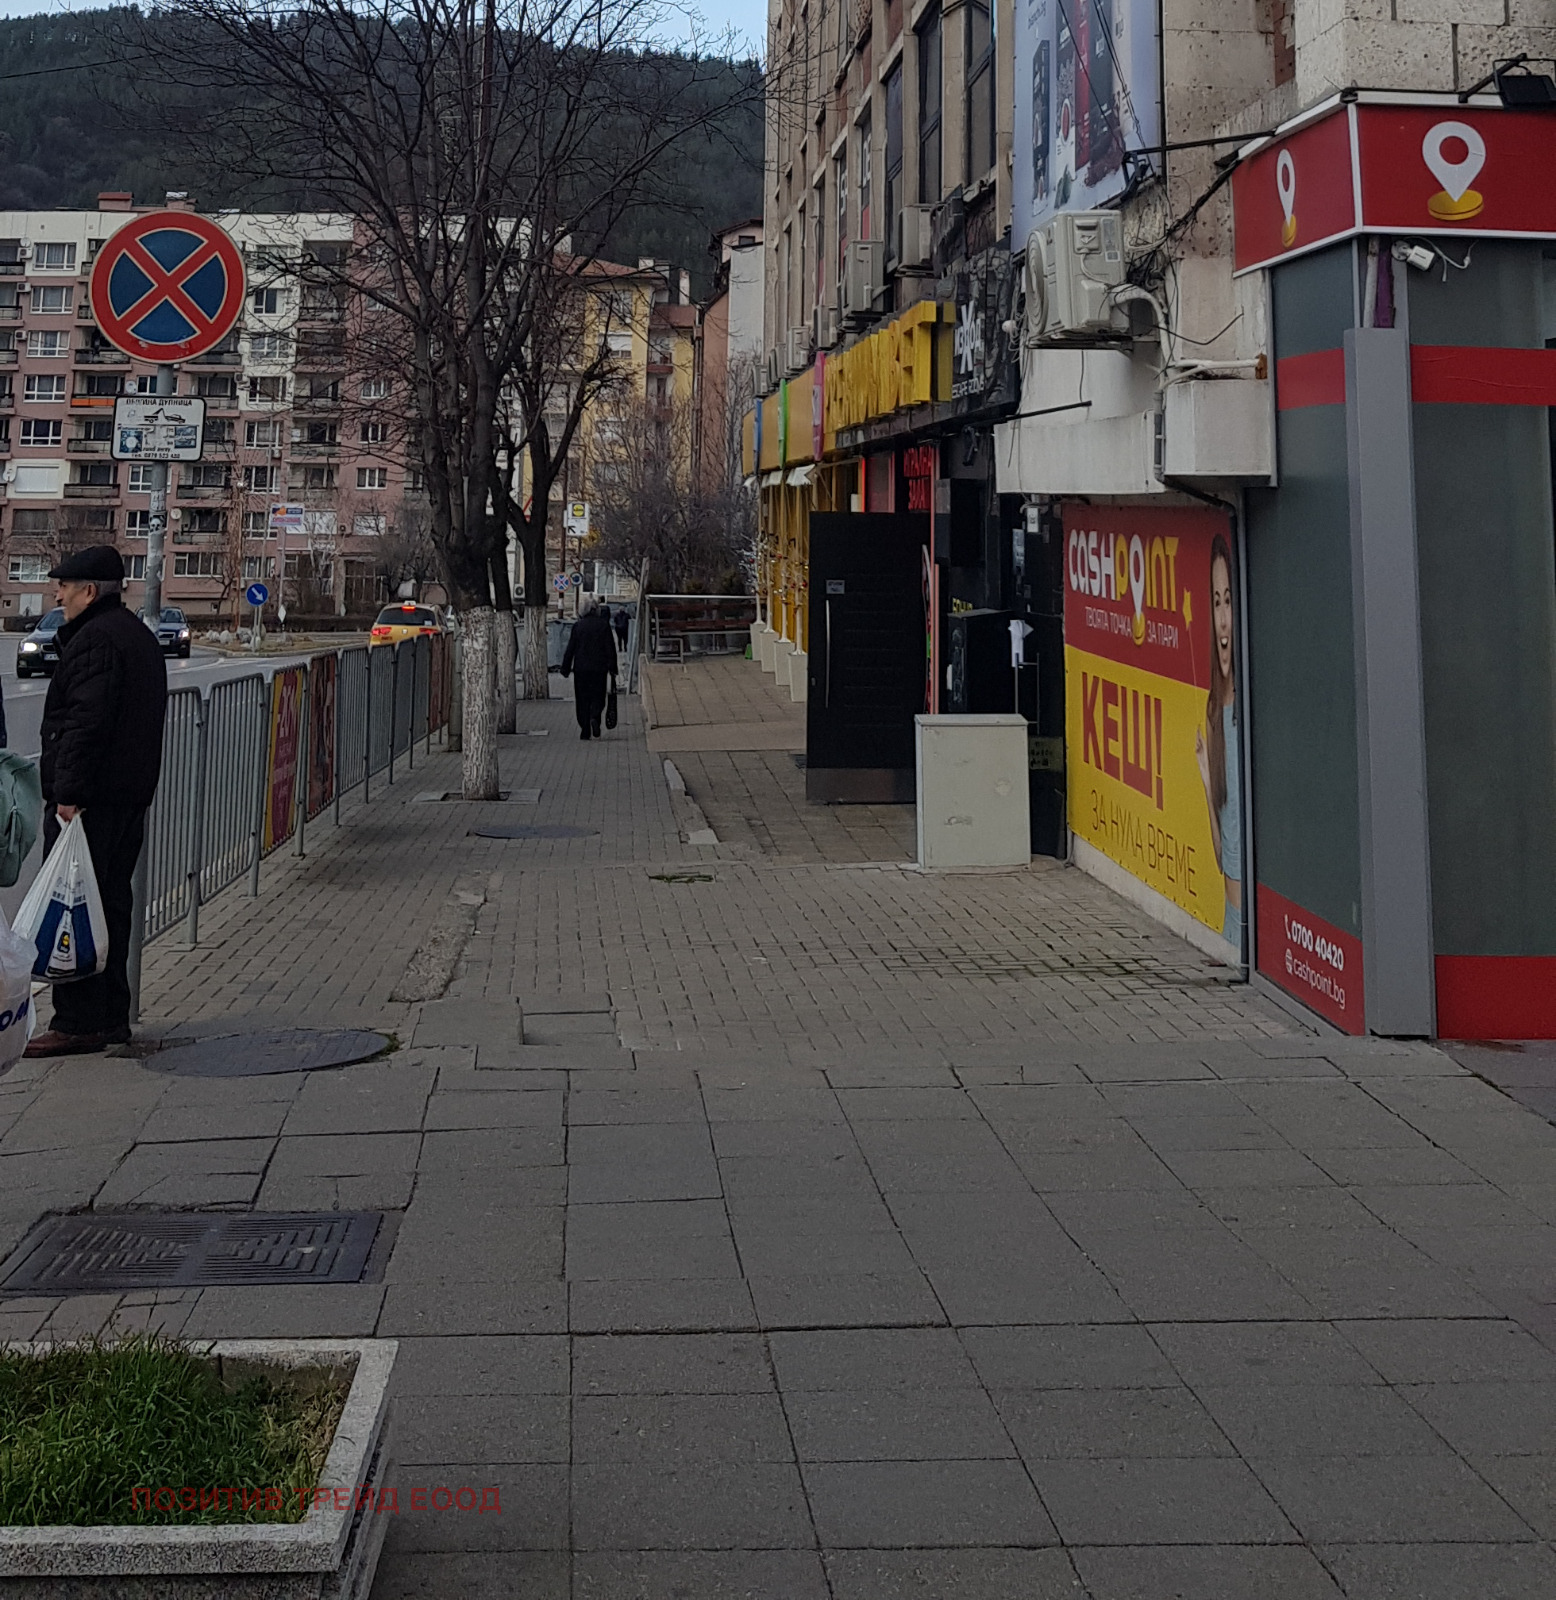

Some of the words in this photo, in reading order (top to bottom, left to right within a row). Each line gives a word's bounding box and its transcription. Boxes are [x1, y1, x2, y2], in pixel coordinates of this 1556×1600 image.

[1085, 606, 1110, 633] ТВОЯТА
[1109, 612, 1133, 638] ТОЧКА
[1147, 620, 1157, 644] ЗА
[1157, 622, 1179, 649] ПАРИ
[1081, 671, 1164, 812] КЕШ!
[1091, 789, 1108, 837] ЗА
[1110, 799, 1145, 863] НУЛА
[1147, 823, 1198, 898] ВРЕМЕ
[1291, 920, 1314, 952] 0700
[1314, 935, 1344, 972] 40420
[1293, 957, 1346, 1010] cashpoint.bg
